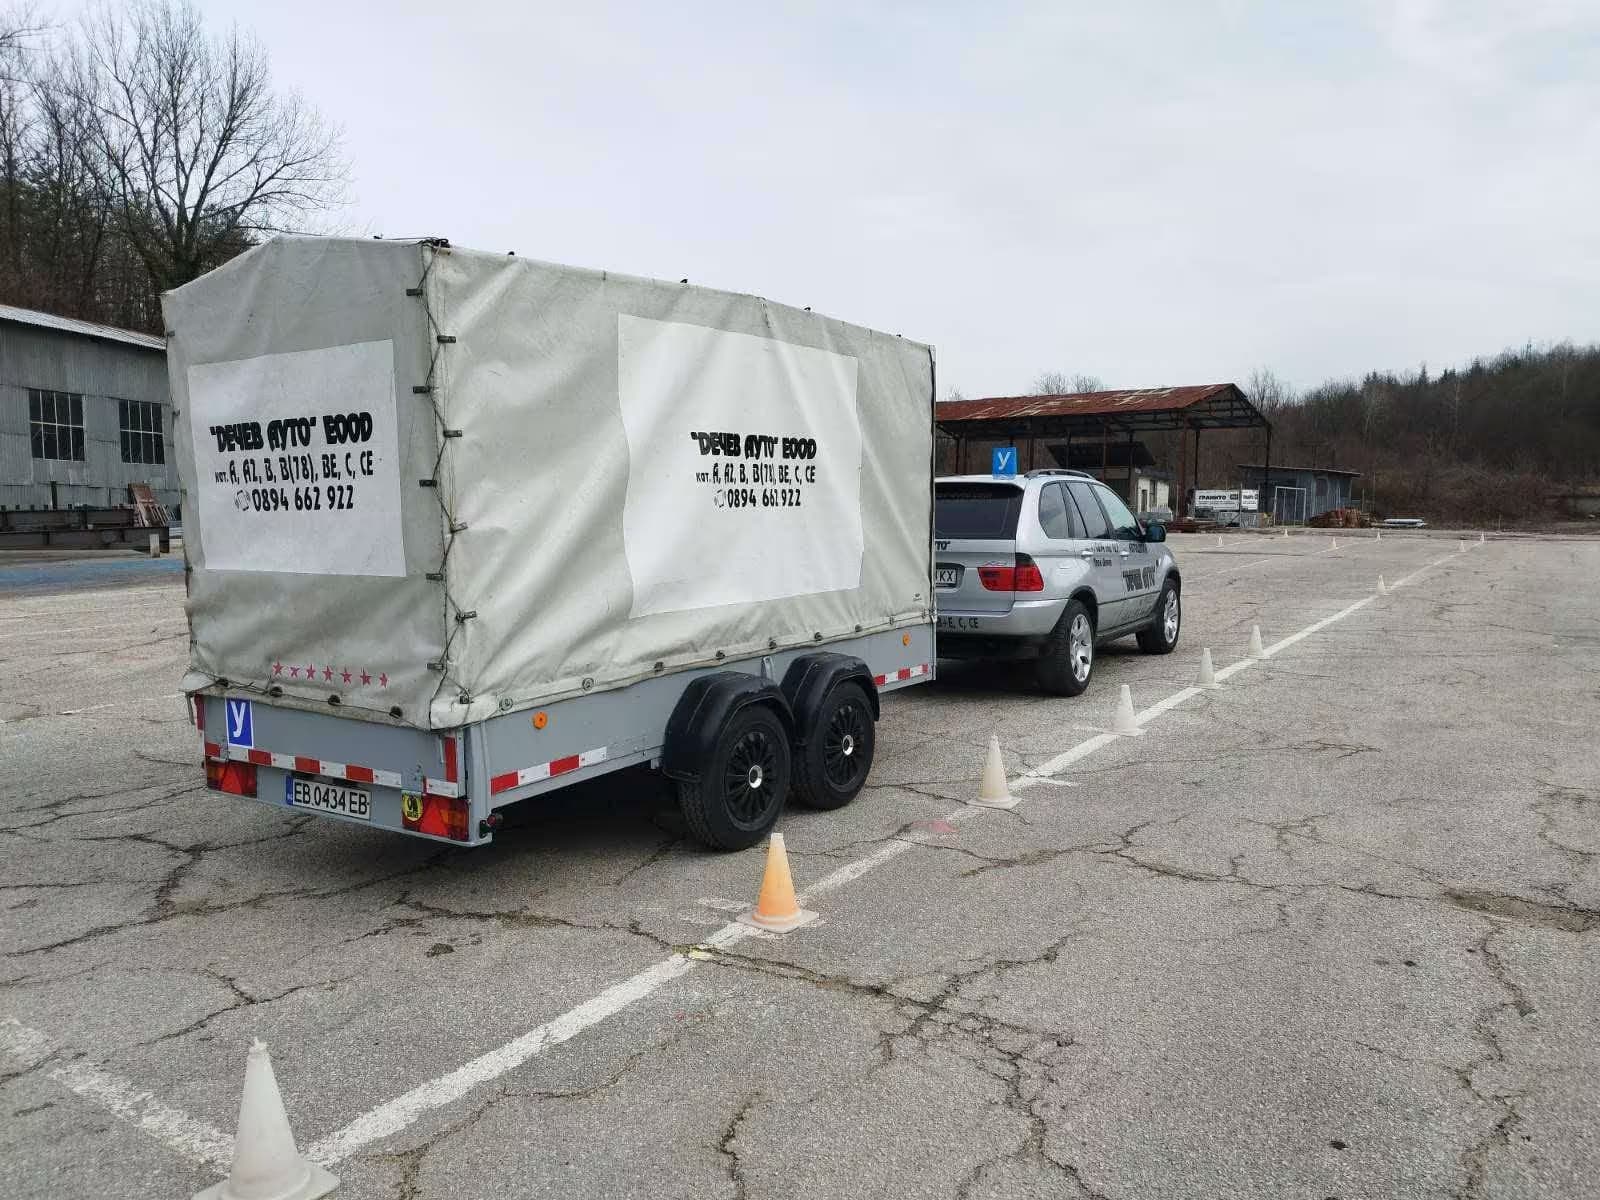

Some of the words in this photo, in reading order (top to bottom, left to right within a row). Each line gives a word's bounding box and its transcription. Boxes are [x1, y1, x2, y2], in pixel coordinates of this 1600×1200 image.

[360, 450, 373, 476] CE
[252, 488, 289, 512] 0894
[295, 486, 320, 511] 662
[327, 485, 354, 510] 922
[727, 488, 757, 508] 0894
[781, 488, 801, 507] 922
